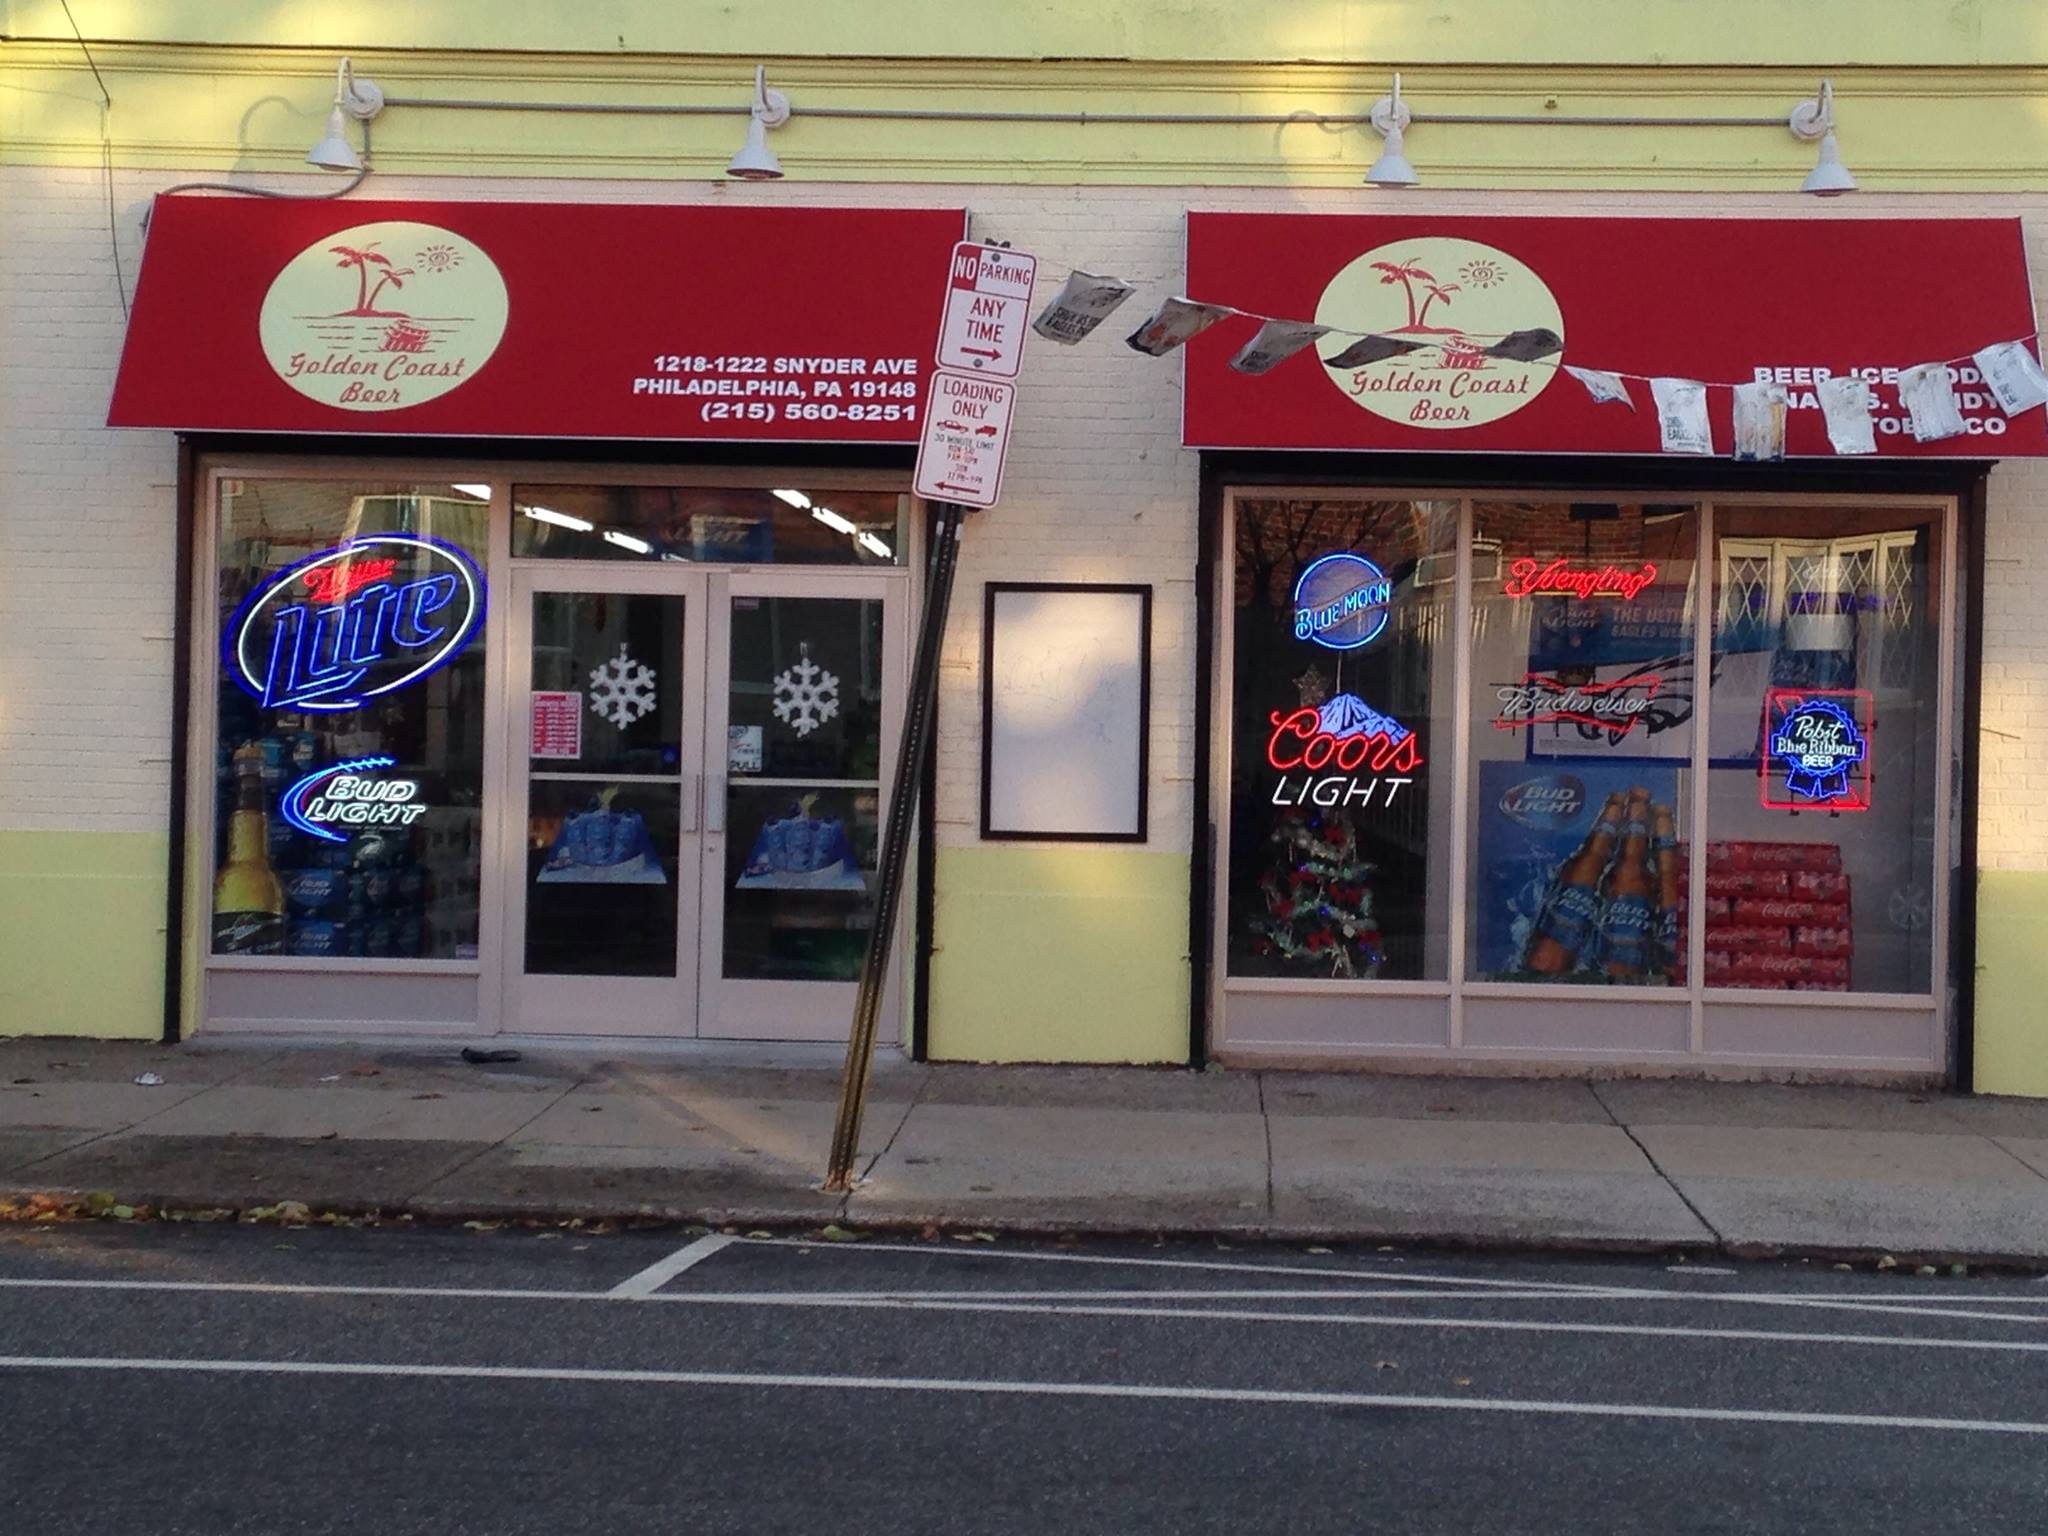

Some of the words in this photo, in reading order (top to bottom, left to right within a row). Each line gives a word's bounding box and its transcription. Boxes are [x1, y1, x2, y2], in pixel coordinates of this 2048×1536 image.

[955, 255, 977, 280] NO
[980, 262, 1031, 286] PARKING
[970, 297, 1006, 319] ANY
[967, 320, 1004, 343] TIME
[285, 353, 377, 378] Golden
[384, 355, 465, 381] Coast
[654, 355, 767, 373] 1218-1222
[773, 358, 866, 375] SNYDER
[872, 359, 918, 375] AVE
[340, 382, 400, 403] Beer
[633, 378, 807, 399] PHILADELPHIA,
[814, 381, 842, 397] PA
[849, 382, 916, 397] 19148
[943, 379, 1003, 404] LOADING
[1350, 371, 1441, 396] Golden
[1450, 372, 1529, 398] Coast
[701, 402, 775, 423] (215)
[784, 404, 916, 421] 560-8251
[952, 400, 988, 420] ONLY
[1410, 400, 1471, 421] Beer
[1504, 558, 1658, 600] Yuengling
[1343, 583, 1391, 616] MOON
[262, 574, 457, 708] Lite
[1497, 686, 1654, 714] Budweiser
[1268, 707, 1423, 772] Coors
[1794, 715, 1845, 740] Pabst
[1776, 737, 1808, 753] Blue
[1808, 738, 1857, 756] Ribbon
[1801, 754, 1834, 768] BEER
[324, 776, 417, 802] BUD
[1272, 776, 1413, 808] LIGHT
[1524, 787, 1575, 800] BUD
[304, 797, 427, 825] LIGHT
[1512, 799, 1581, 813] LIGHT
